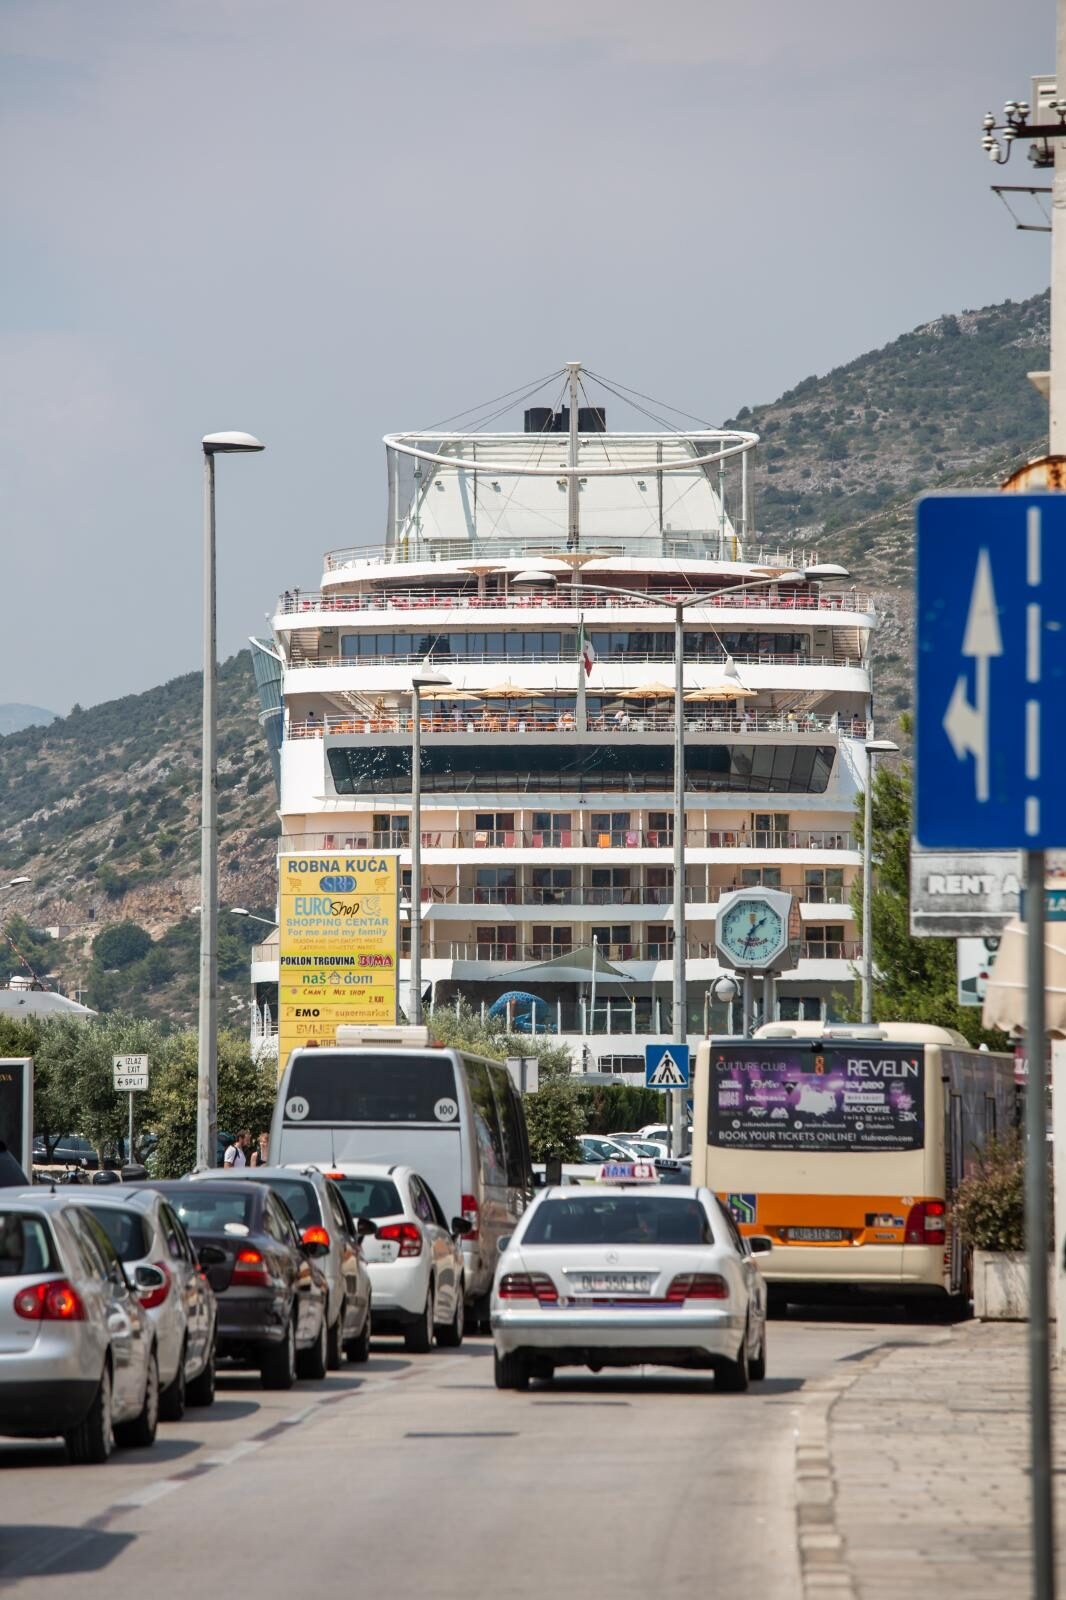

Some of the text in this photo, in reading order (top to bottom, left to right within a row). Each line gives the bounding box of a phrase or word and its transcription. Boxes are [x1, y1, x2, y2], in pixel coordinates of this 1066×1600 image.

[288, 856, 388, 872] ROBNA KUĆA
[928, 874, 1020, 894] RENT A
[294, 897, 360, 918] EURO Shop
[286, 918, 389, 926] SHOPPING CENTAR
[358, 928, 387, 937] family
[281, 954, 393, 966] POKLON TRGOVINA BIMA
[302, 972, 373, 984] naš dom
[716, 1062, 786, 1072] CULTURE CLUB
[848, 1059, 918, 1077] REVELIN
[291, 1103, 304, 1113] 80
[439, 1105, 454, 1115] 100
[718, 1131, 747, 1140] BOOK
[748, 1132, 775, 1140] YOUR
[778, 1132, 815, 1140] TICKETS
[816, 1133, 856, 1141] ONLINE!
[606, 1165, 630, 1176] TAXI
